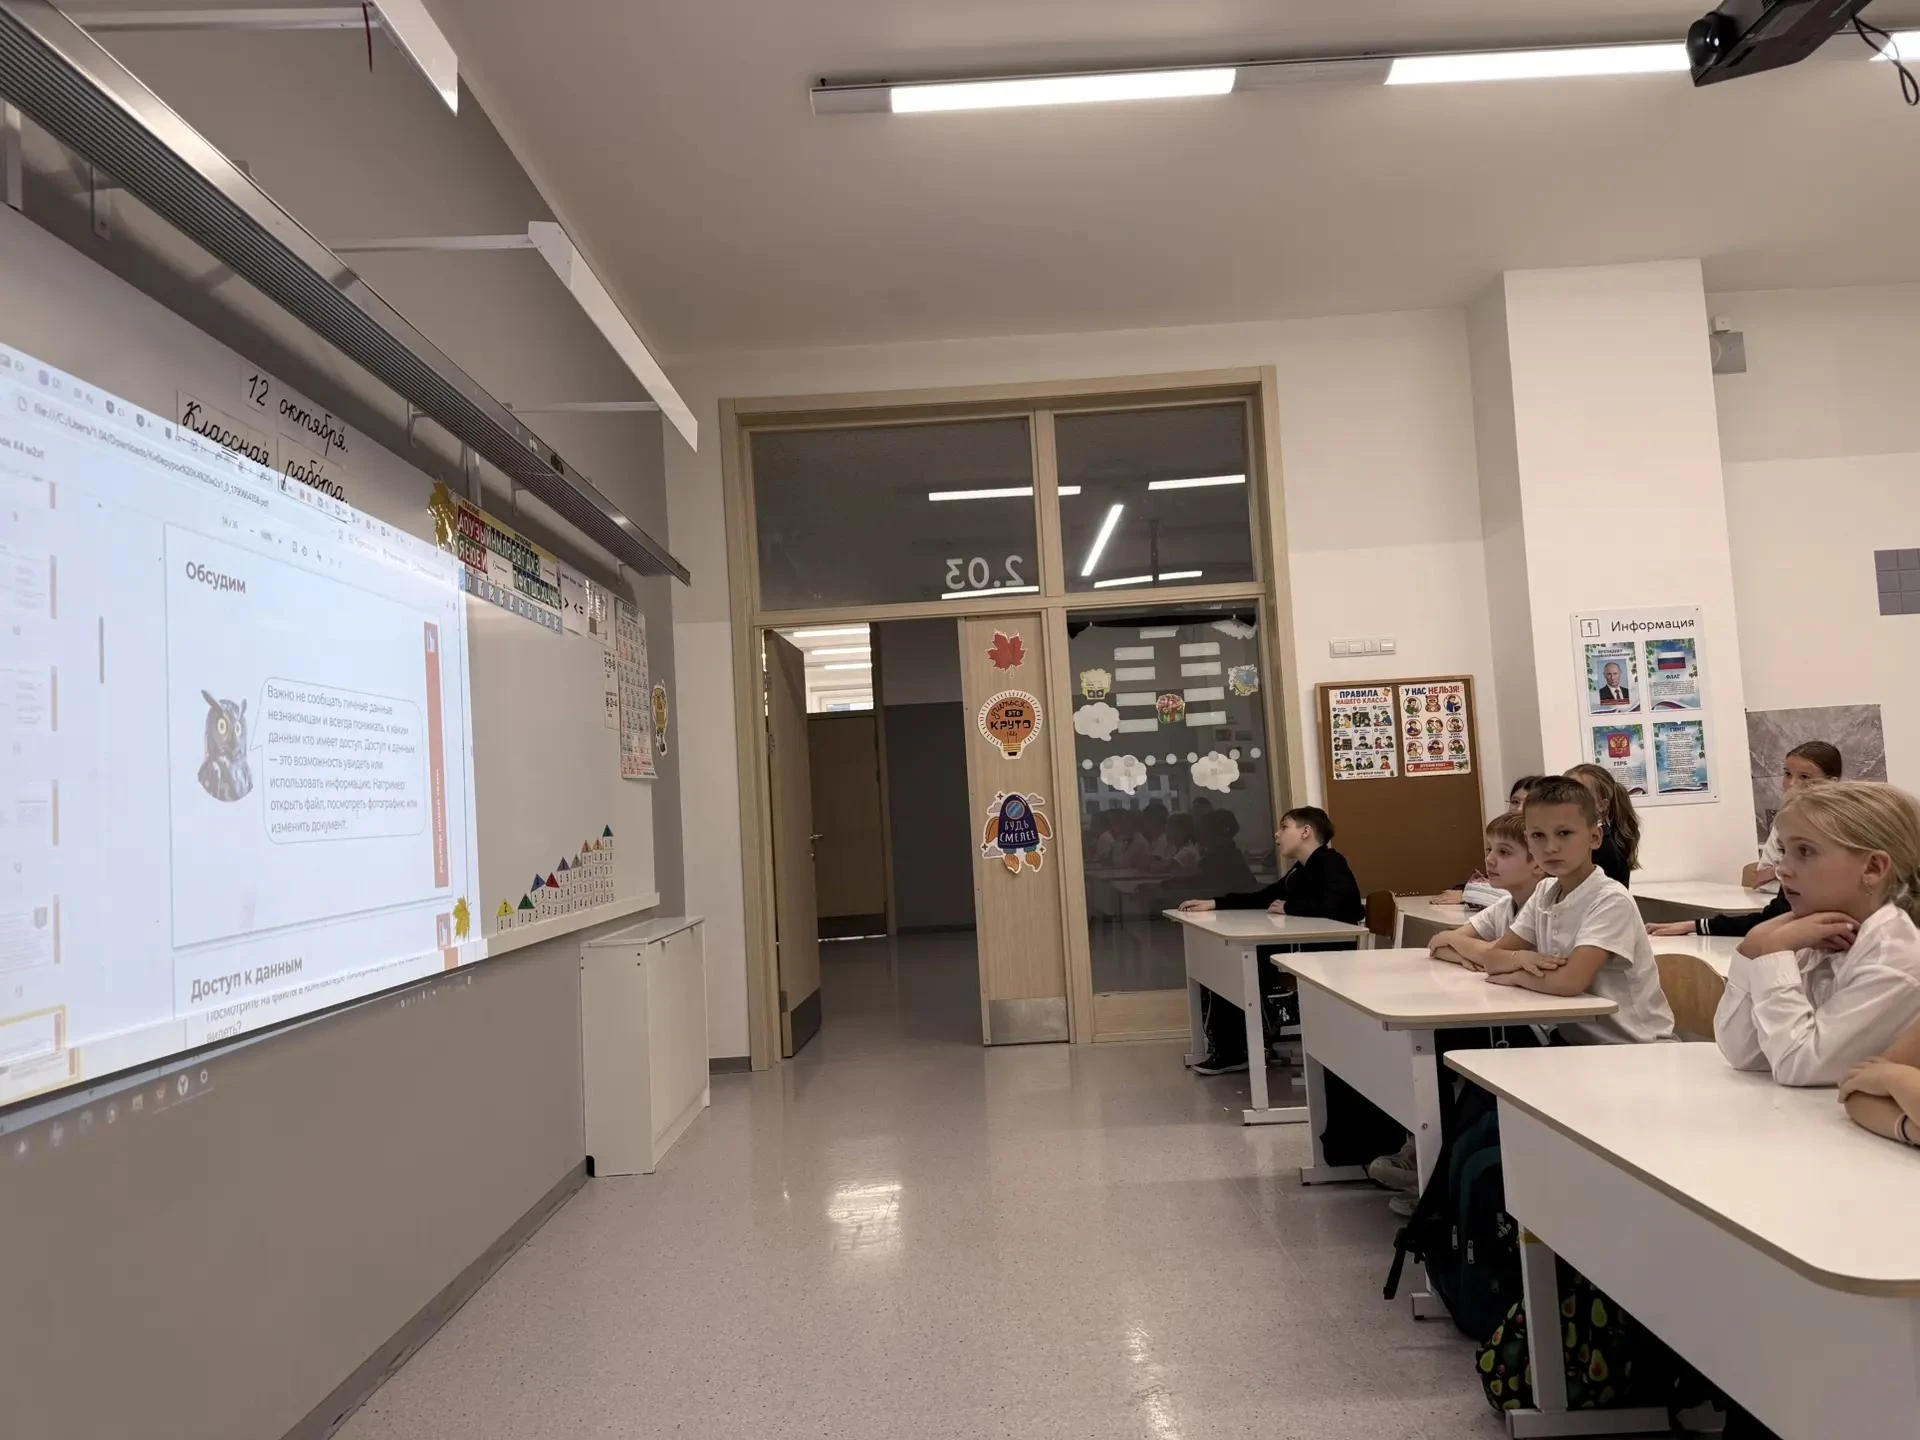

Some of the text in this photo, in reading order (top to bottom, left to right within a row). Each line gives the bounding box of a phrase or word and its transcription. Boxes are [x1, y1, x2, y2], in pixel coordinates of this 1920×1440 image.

[249, 374, 269, 407] 12
[182, 400, 270, 468] Классная
[186, 561, 247, 594] Обсудим
[1611, 619, 1695, 633] Информация
[267, 685, 295, 701] Важно
[296, 692, 305, 703] не
[307, 693, 342, 708] сообщать
[1339, 689, 1379, 699] ПРАВИЛА
[1405, 685, 1460, 696] У НАС НЕЛЬЗЯ!
[268, 710, 321, 726] незнакомцам
[323, 717, 328, 726] и
[329, 717, 352, 730] всегда
[990, 719, 1031, 730] КРУТО
[268, 732, 301, 745] данным
[302, 736, 315, 746] кто
[279, 755, 293, 766] это
[294, 757, 343, 768] возможность
[270, 777, 324, 789] использовать
[270, 799, 304, 811] открыть
[271, 821, 311, 834] изменить
[1004, 820, 1030, 832] БУДЬ
[999, 830, 1037, 843] СМЕЛЕЕ
[190, 971, 242, 1004] Доступ
[244, 971, 253, 985] к
[255, 957, 303, 985] данным
